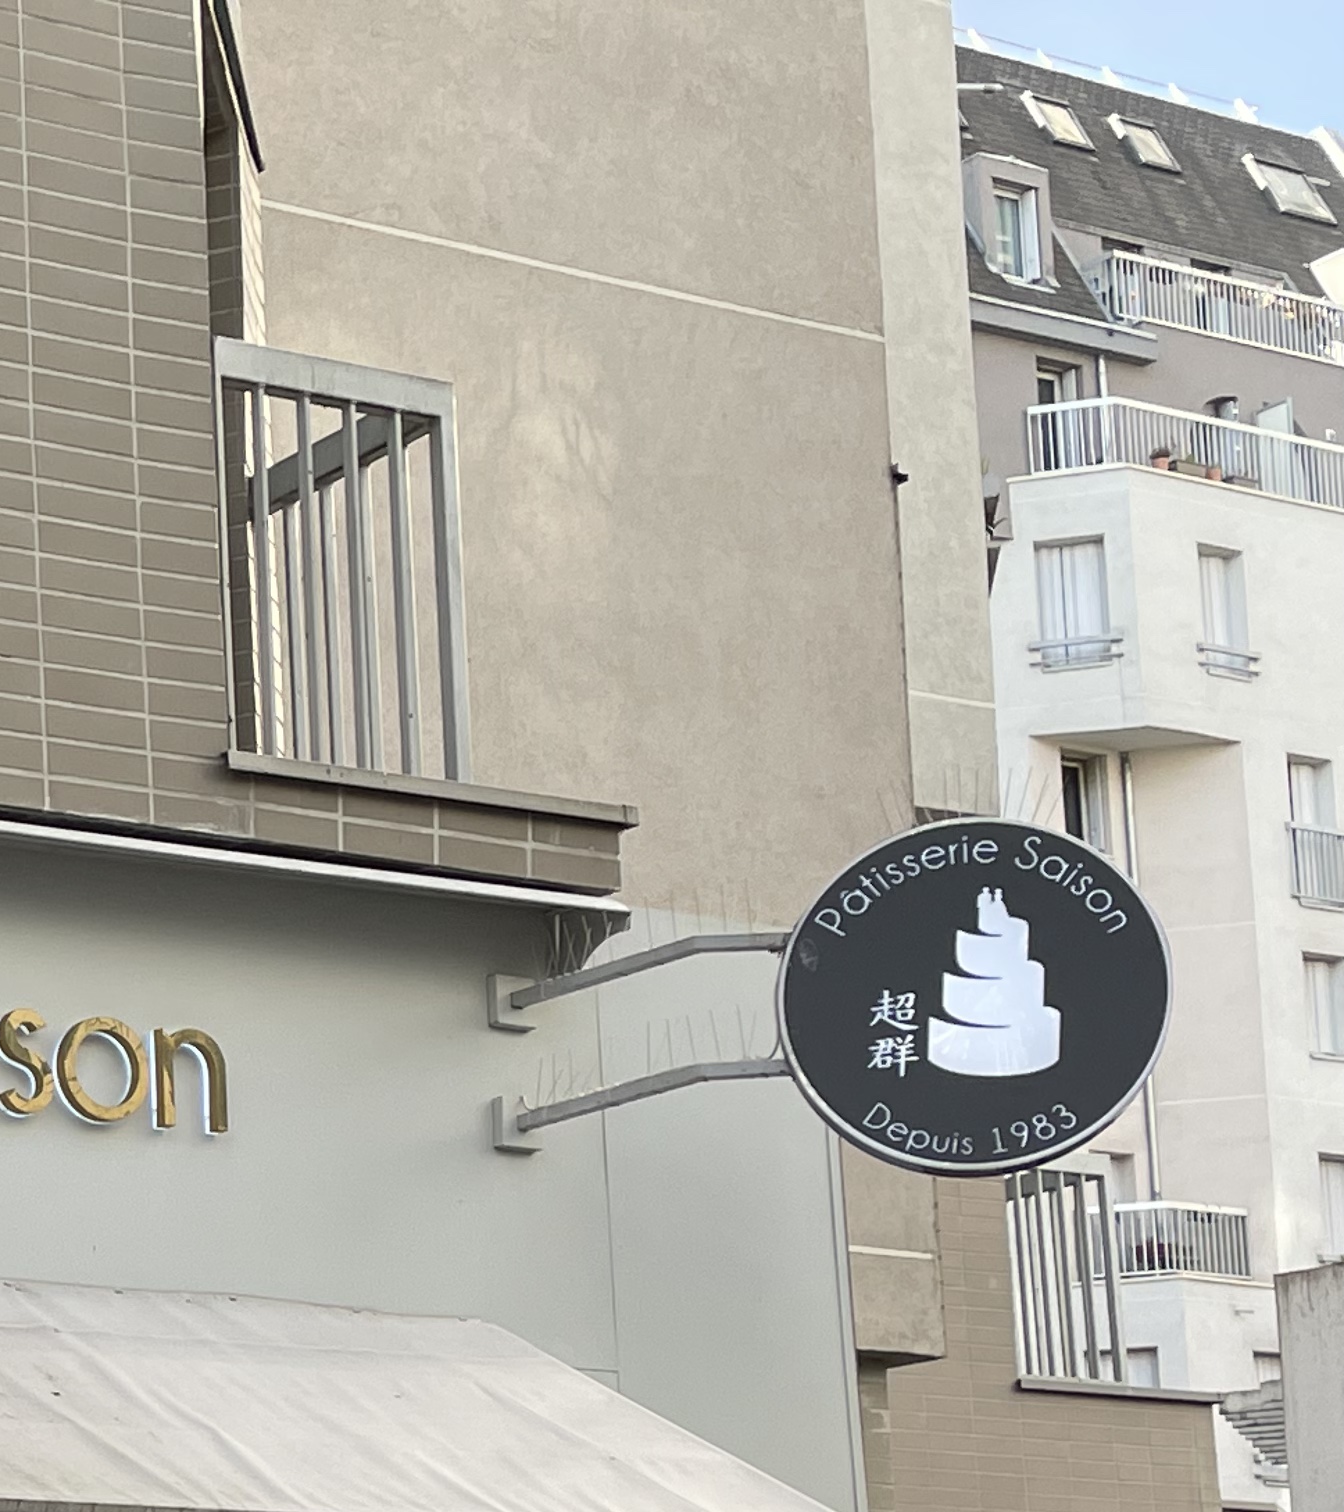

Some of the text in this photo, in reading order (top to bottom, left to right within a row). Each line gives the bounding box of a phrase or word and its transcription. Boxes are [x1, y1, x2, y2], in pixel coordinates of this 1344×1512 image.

[814, 835, 1128, 937] Pâtisserie Saison
[867, 989, 920, 1078] 超群
[862, 1102, 1078, 1156] Depuis 1983
